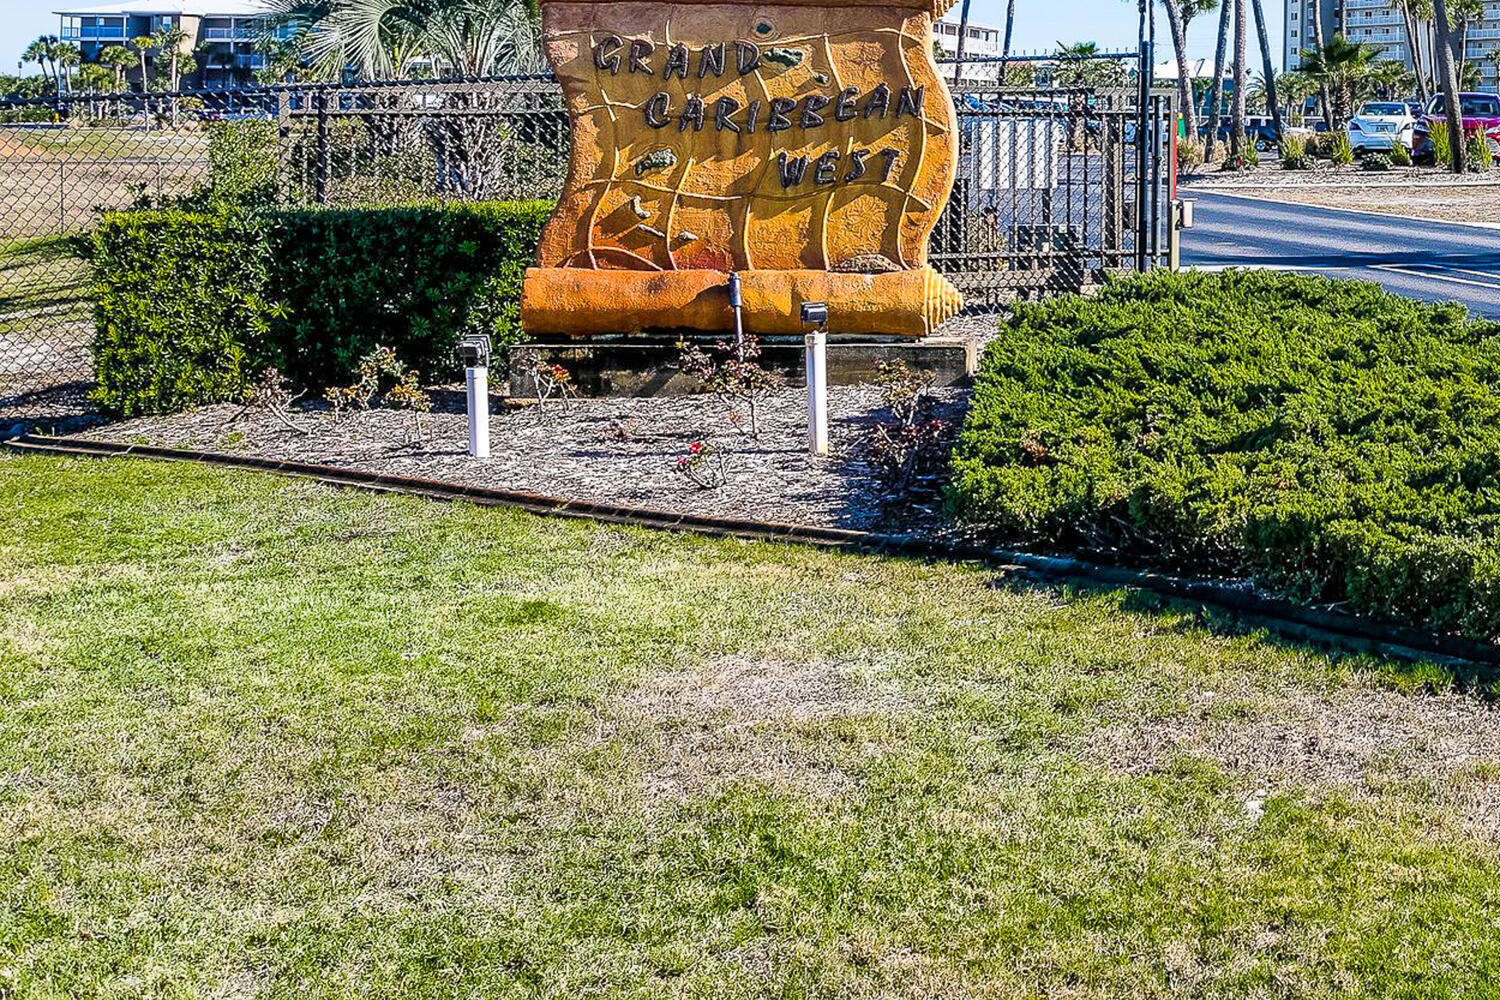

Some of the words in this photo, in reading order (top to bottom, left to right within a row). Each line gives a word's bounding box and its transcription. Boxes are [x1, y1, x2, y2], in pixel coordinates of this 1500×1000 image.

[594, 36, 761, 80] GRAND
[645, 83, 924, 133] CARIBBEAN
[779, 148, 901, 189] WEST
